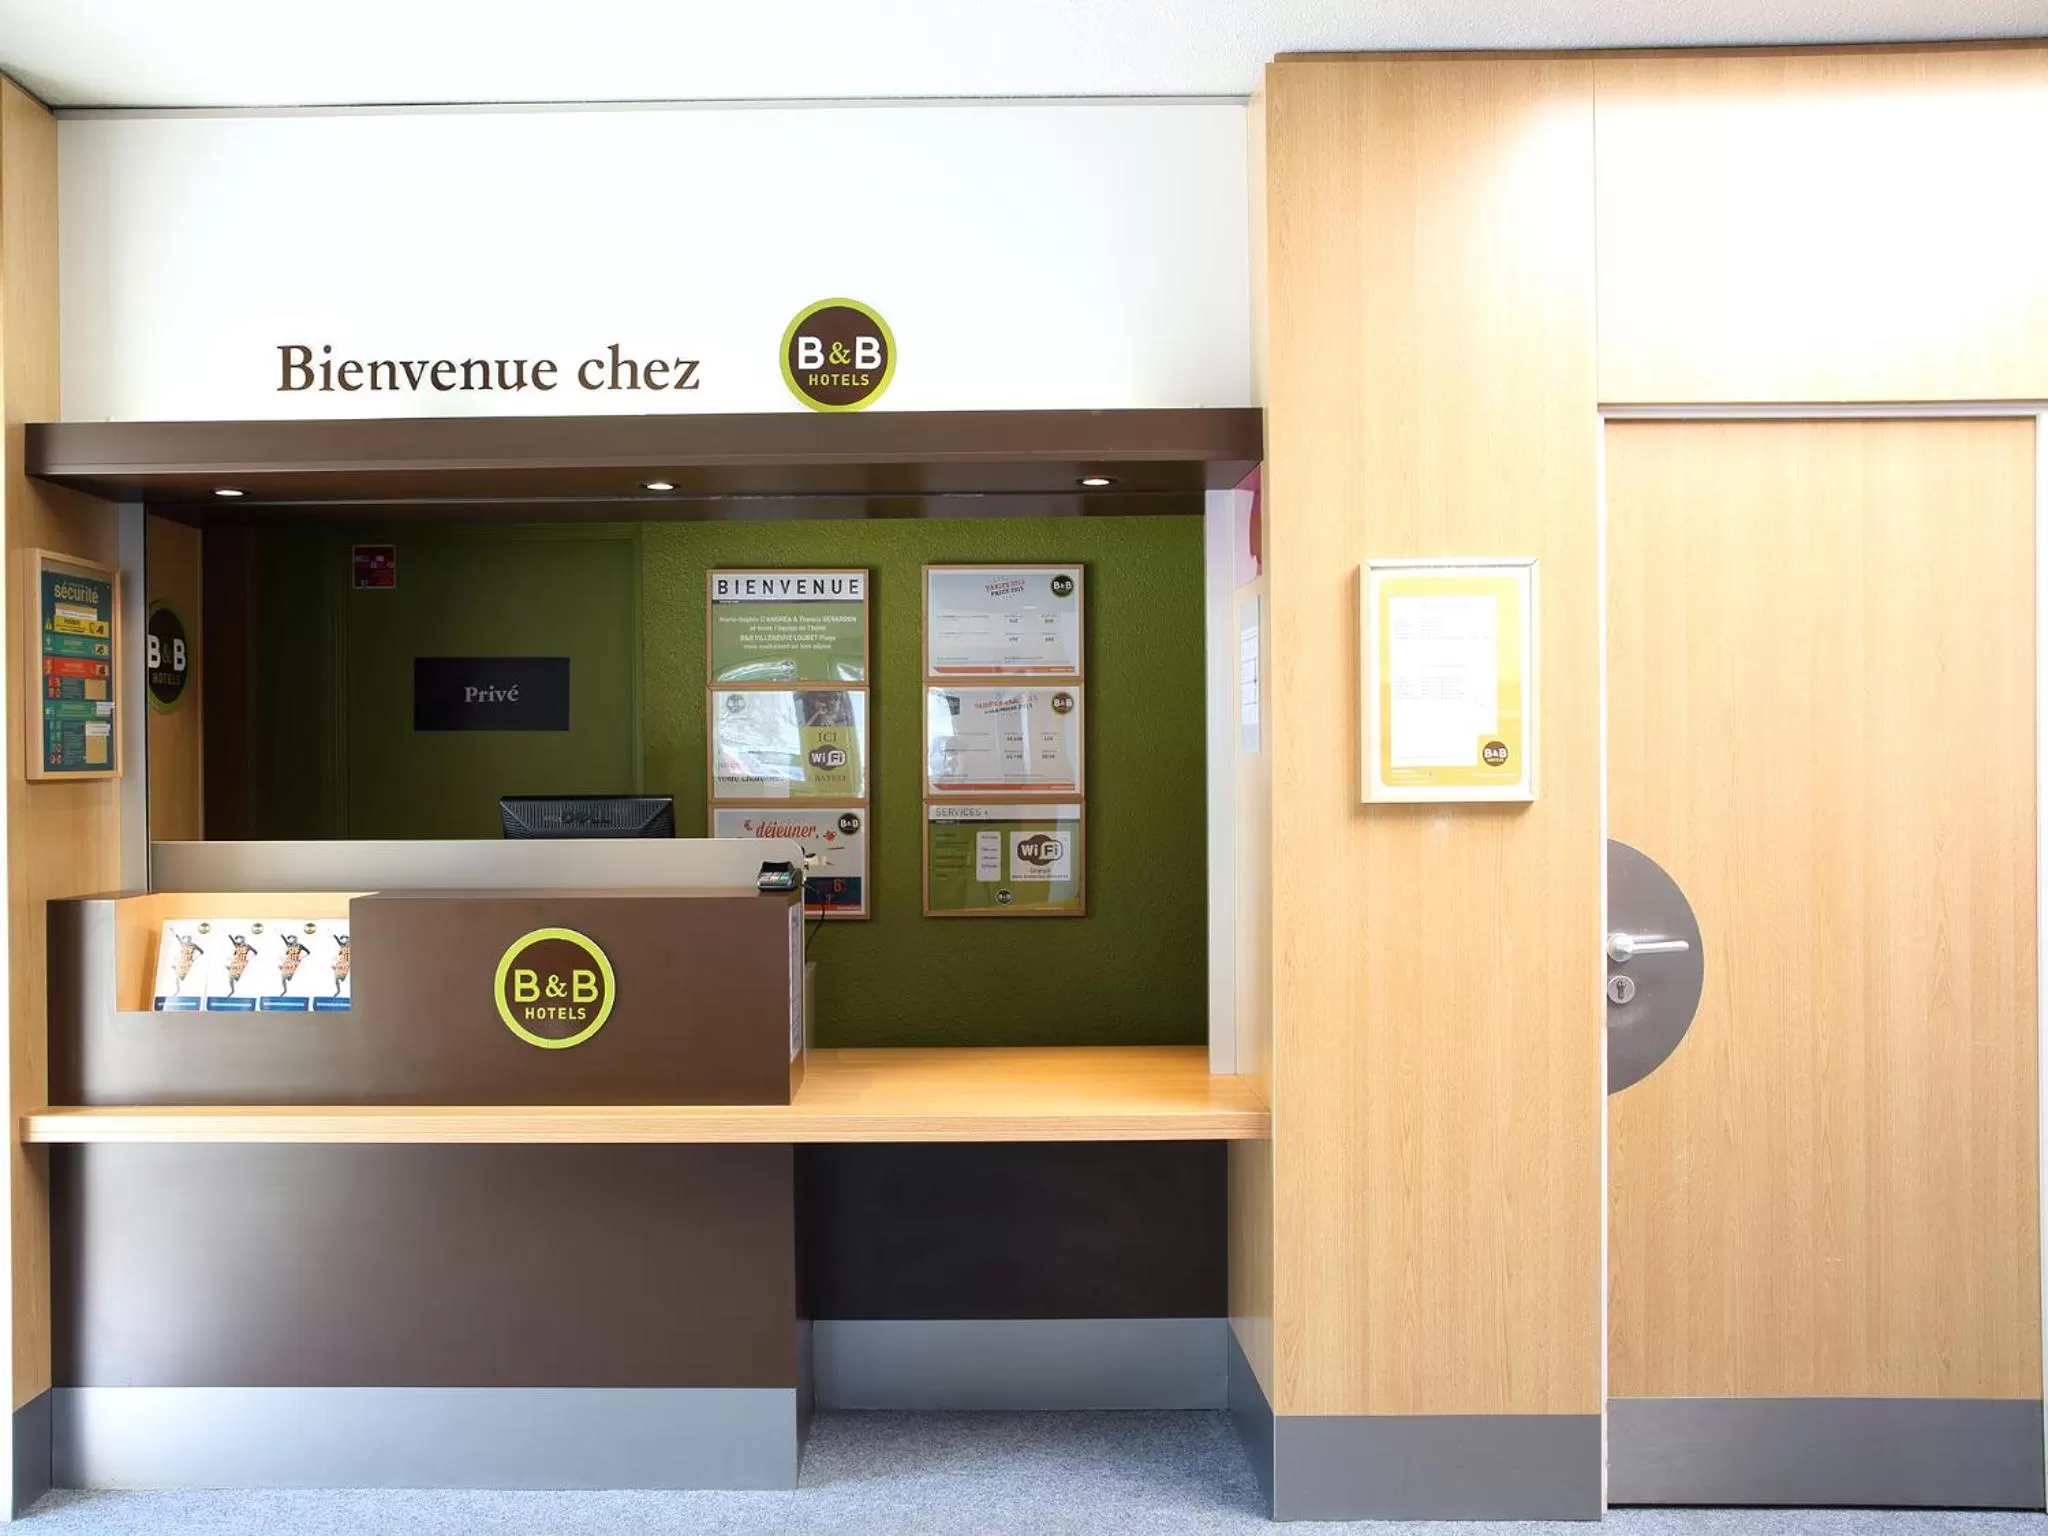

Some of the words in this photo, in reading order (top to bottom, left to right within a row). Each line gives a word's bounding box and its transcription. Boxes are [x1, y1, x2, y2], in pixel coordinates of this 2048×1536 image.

[798, 336, 881, 369] B&B
[277, 344, 558, 391] Bienvenue
[577, 343, 700, 391] chez
[808, 374, 870, 386] HOTELS
[54, 581, 99, 604] sécurité
[717, 579, 860, 595] BIENVENUE
[147, 634, 187, 671] B&B
[152, 672, 181, 685] HOTELS
[463, 684, 520, 702] Privé
[935, 807, 982, 818] SERVICES
[1020, 842, 1060, 857] WiFi
[514, 969, 599, 1002] B&B
[525, 1007, 587, 1020] HOTELS
